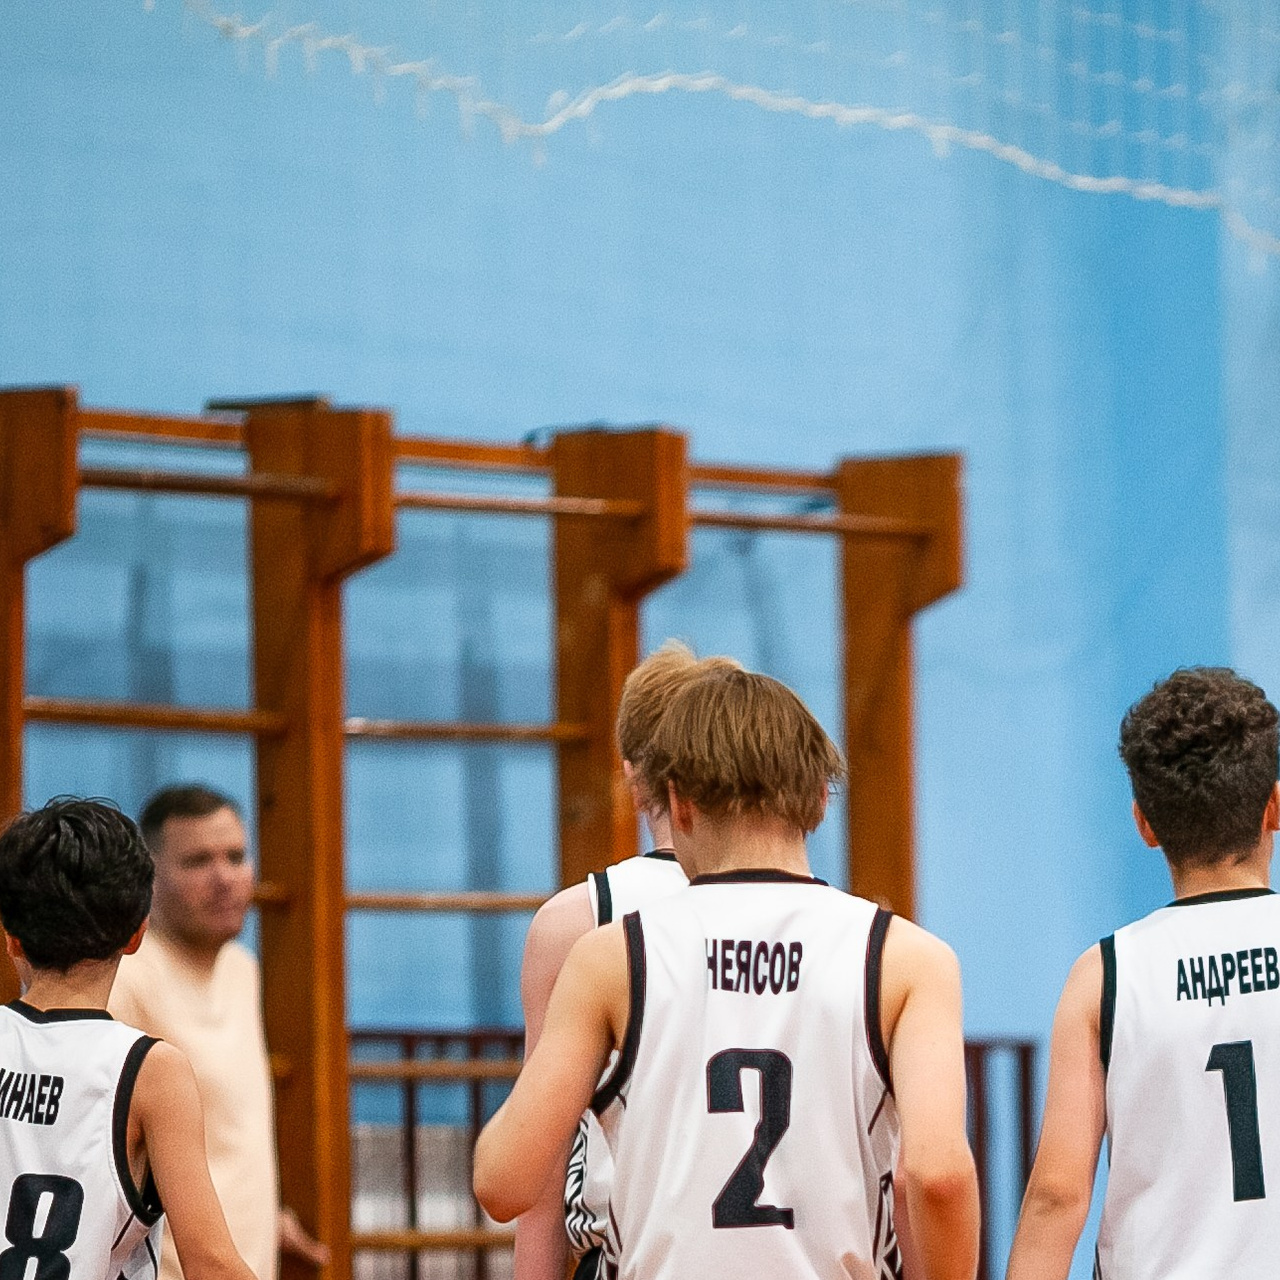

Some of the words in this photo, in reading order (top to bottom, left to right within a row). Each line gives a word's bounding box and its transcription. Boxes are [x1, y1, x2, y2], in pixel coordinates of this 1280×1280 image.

[1176, 947, 1280, 1007] АНДРЕЕВ
[706, 1048, 795, 1229] 2
[1205, 1039, 1266, 1202] 1
